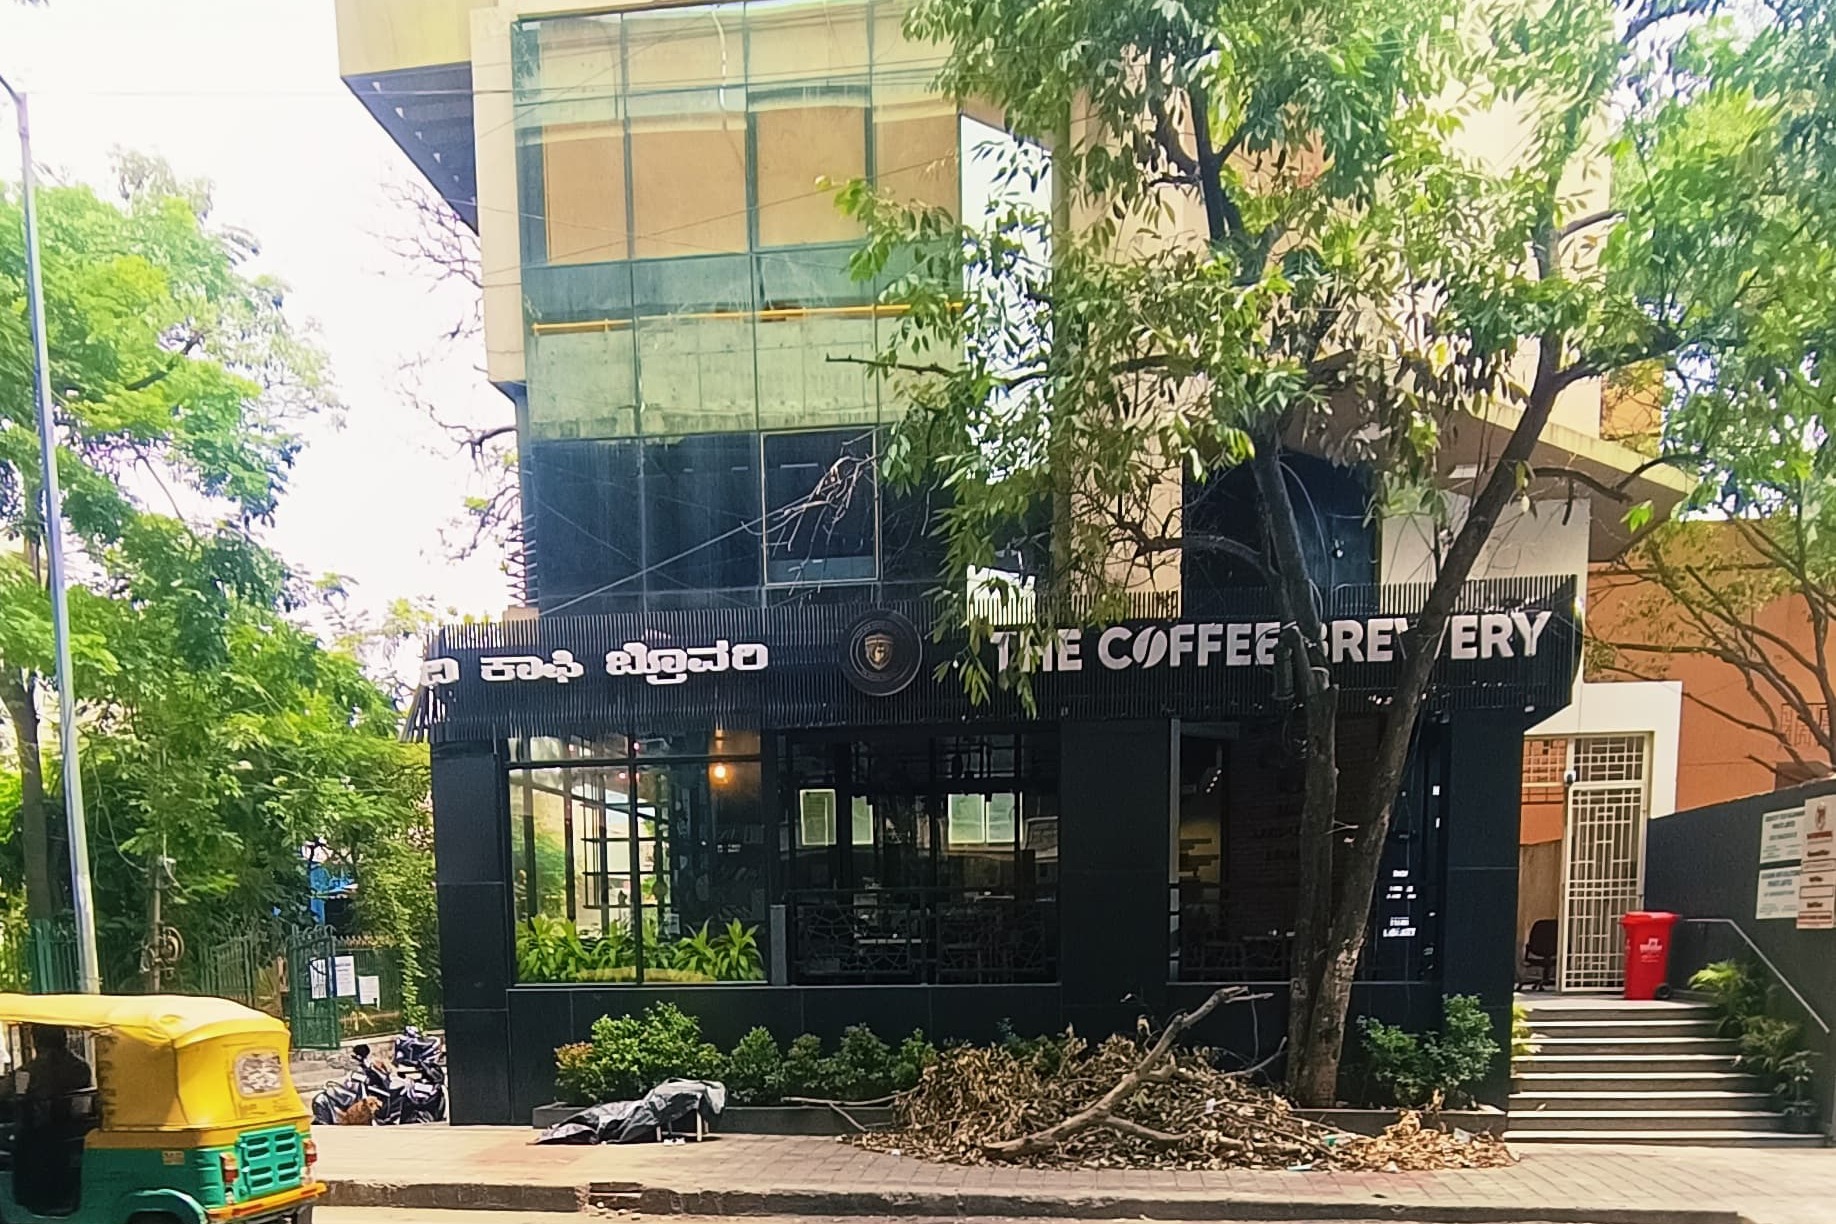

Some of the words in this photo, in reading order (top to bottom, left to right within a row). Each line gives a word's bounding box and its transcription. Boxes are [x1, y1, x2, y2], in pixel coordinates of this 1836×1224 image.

[990, 628, 1082, 672] THE
[1098, 622, 1281, 670] COFFEE
[1319, 610, 1552, 663] REERY
[480, 650, 584, 683] ಕಾಫಿ
